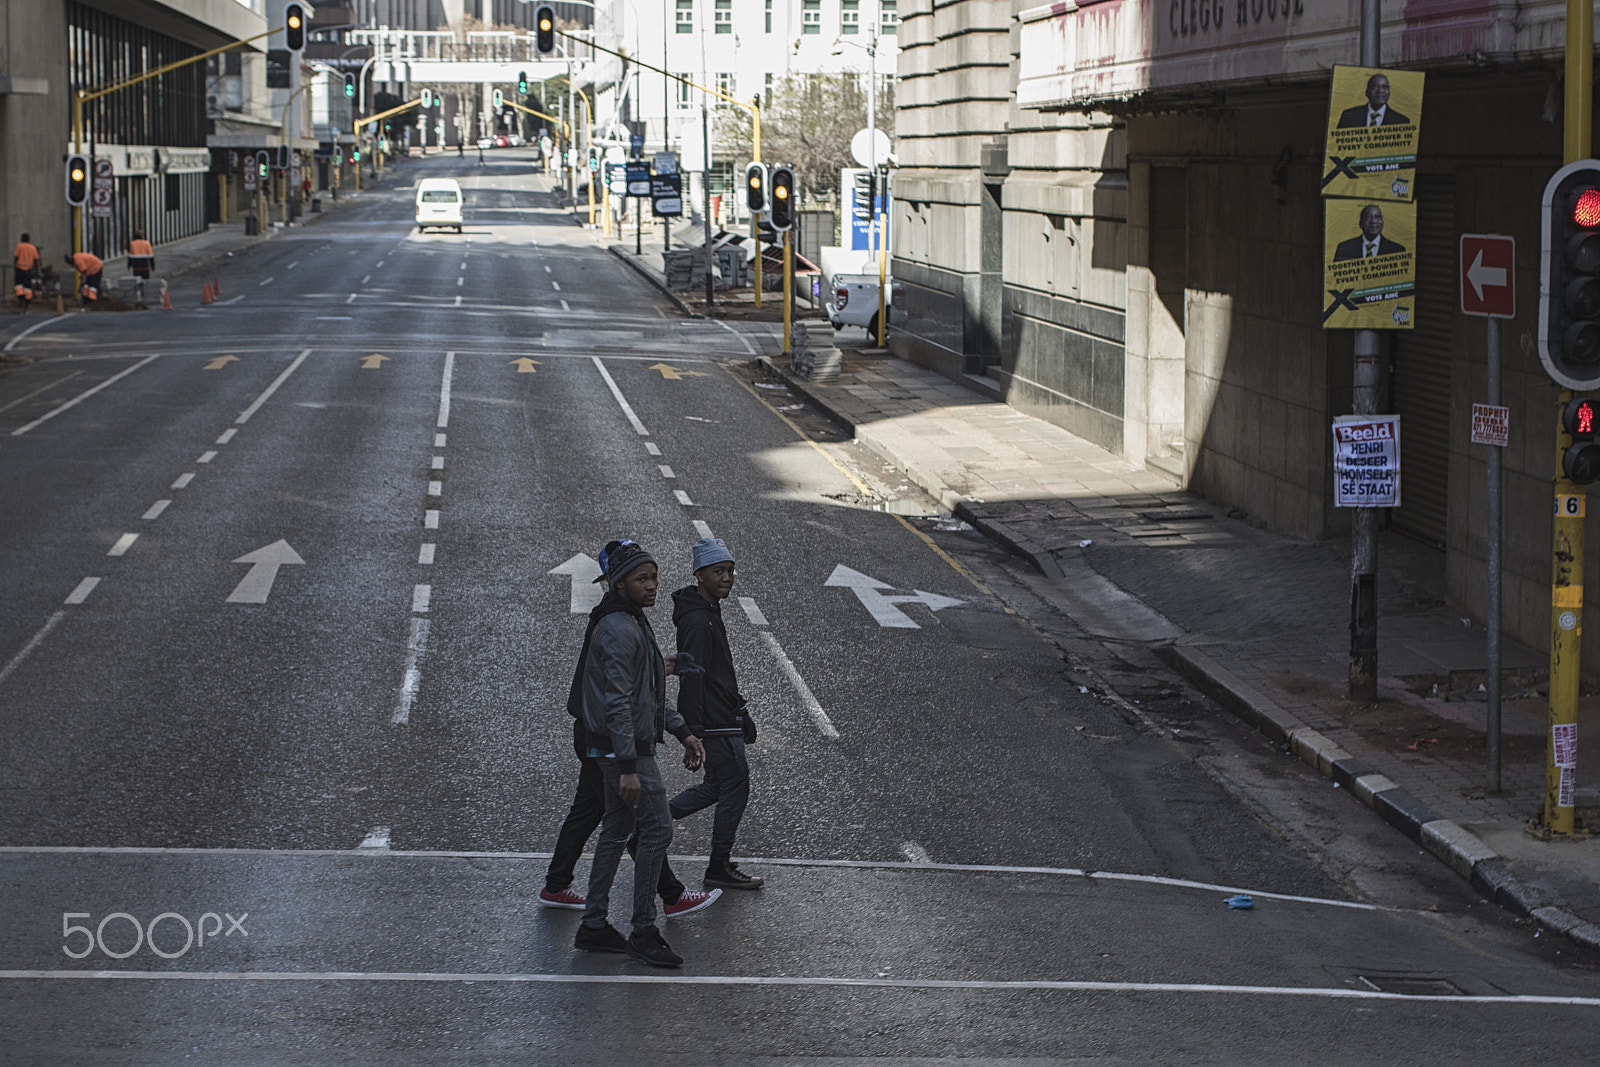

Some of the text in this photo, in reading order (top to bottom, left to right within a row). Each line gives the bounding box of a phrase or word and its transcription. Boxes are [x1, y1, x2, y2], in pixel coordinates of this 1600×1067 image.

[1169, 0, 1224, 36] CLEGG
[1331, 125, 1417, 137] TOGETHER ADVANCING
[1336, 136, 1371, 144] PEOPLE'S
[1374, 133, 1401, 142] POWER
[1364, 140, 1411, 149] COMMUNITY
[1366, 164, 1383, 172] VOTE
[1327, 253, 1413, 271] TOGETHER ADVANCING
[1333, 266, 1368, 277] PEOPLE'S
[1371, 262, 1399, 272] POWER
[1336, 268, 1409, 284] EVERY COMMUNITY
[1365, 291, 1399, 302] VOTE ANC
[1473, 405, 1508, 419] PROPHET
[1338, 423, 1391, 441] Beeld
[1351, 441, 1384, 455] HENRI
[1346, 456, 1387, 466] DESEER
[1341, 480, 1393, 495] SÊ STAAT
[1554, 727, 1564, 764] ABORTION
[1560, 768, 1570, 805] ABORTION
